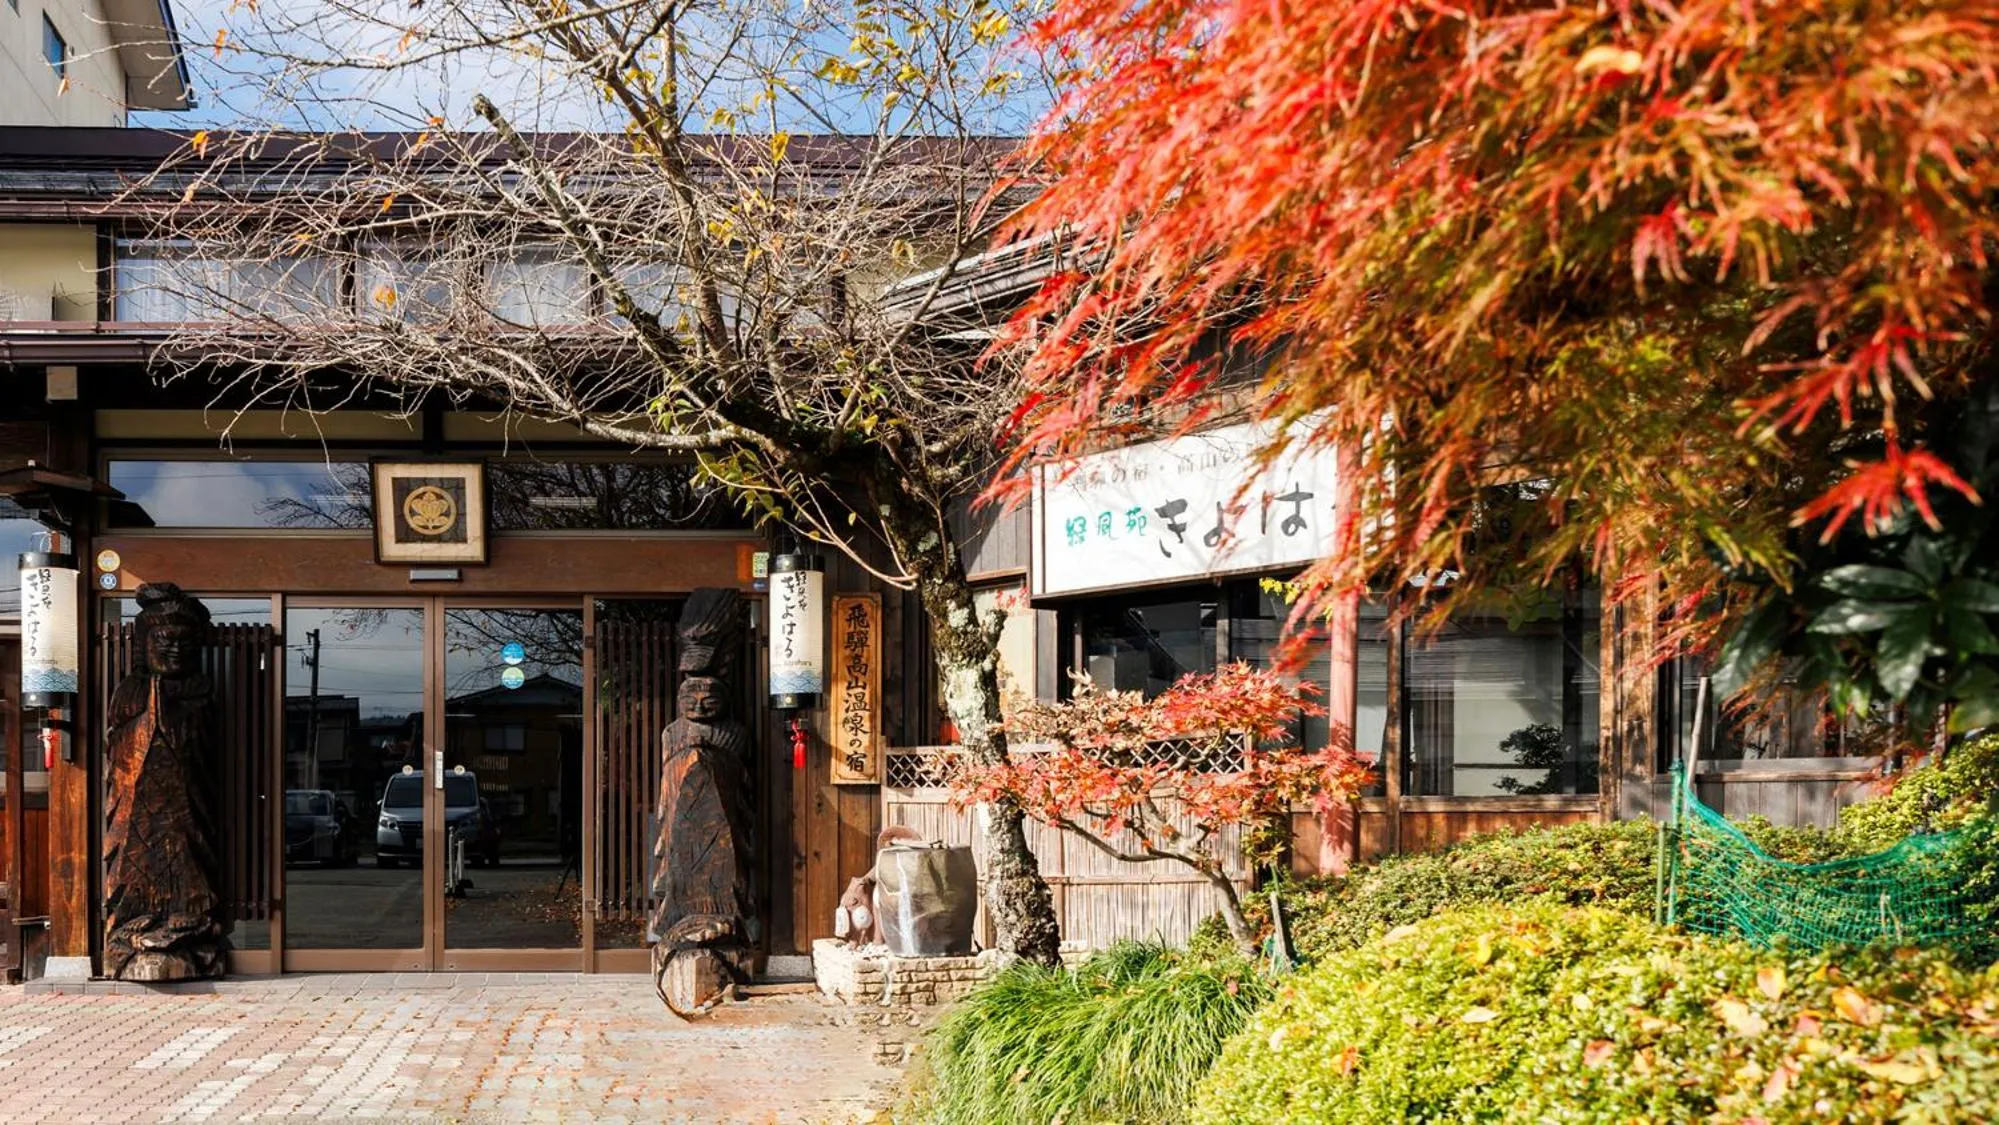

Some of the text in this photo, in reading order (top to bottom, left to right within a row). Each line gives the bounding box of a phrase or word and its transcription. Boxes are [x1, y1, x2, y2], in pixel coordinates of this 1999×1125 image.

[1154, 481, 1337, 558] きよは
[781, 575, 797, 658] きよはる
